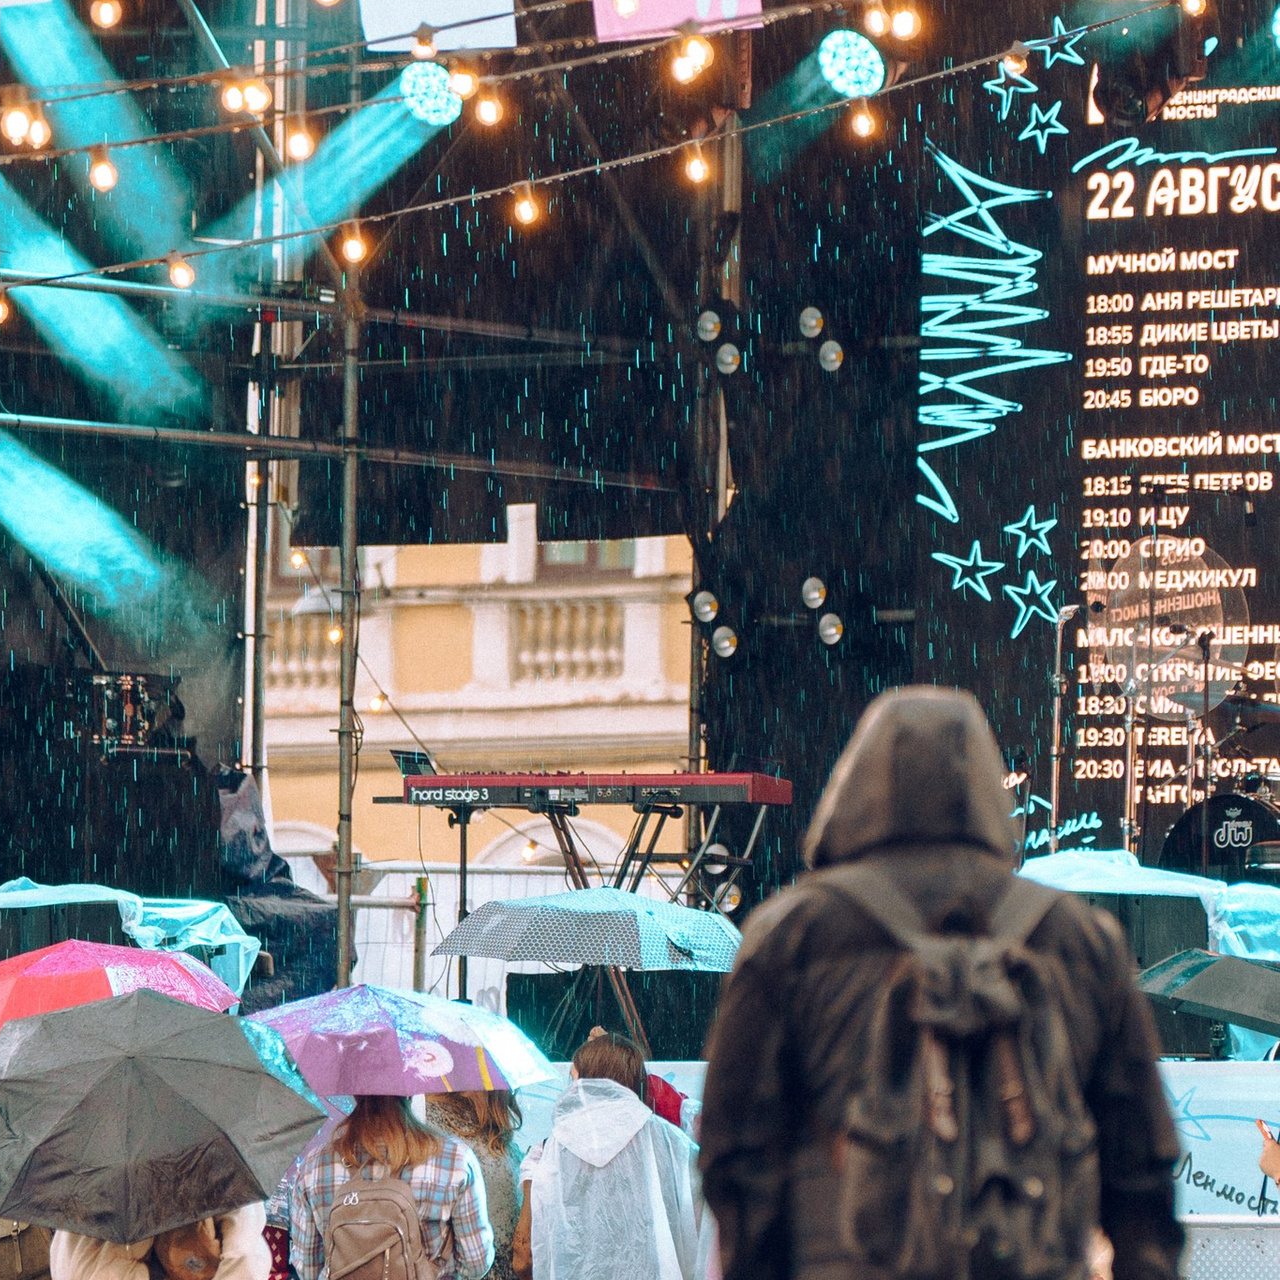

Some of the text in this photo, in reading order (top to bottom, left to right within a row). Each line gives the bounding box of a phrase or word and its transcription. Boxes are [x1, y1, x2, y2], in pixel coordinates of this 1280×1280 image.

[1170, 85, 1280, 105] ЕНИНГРАДСКИ
[1163, 103, 1218, 120] МОСТЫ
[1086, 171, 1136, 220] 22
[1086, 247, 1240, 275] МУЧНОЙ МОСТ
[1086, 293, 1134, 314] 18:00
[1140, 291, 1184, 312] АНЯ
[1085, 319, 1279, 347] 18:55 ДИКИЕ ЦВЕТЫ
[1084, 354, 1210, 378] 19:50 ГДЕ-ТО
[1083, 386, 1200, 409] 20:45 БЮРО
[1081, 430, 1280, 459] БАНКОВСКИЙ МОСТ
[1082, 475, 1133, 497] 18:15
[1192, 471, 1274, 492] ПЕТРОВ
[1082, 507, 1131, 528] 19:10
[1080, 538, 1131, 560] 20:00
[1137, 568, 1257, 592] МЕДЖИКУЛ
[1075, 727, 1126, 747] 19:30
[1074, 759, 1125, 780] 20:30
[445, 787, 480, 803] stage
[481, 787, 489, 801] 3
